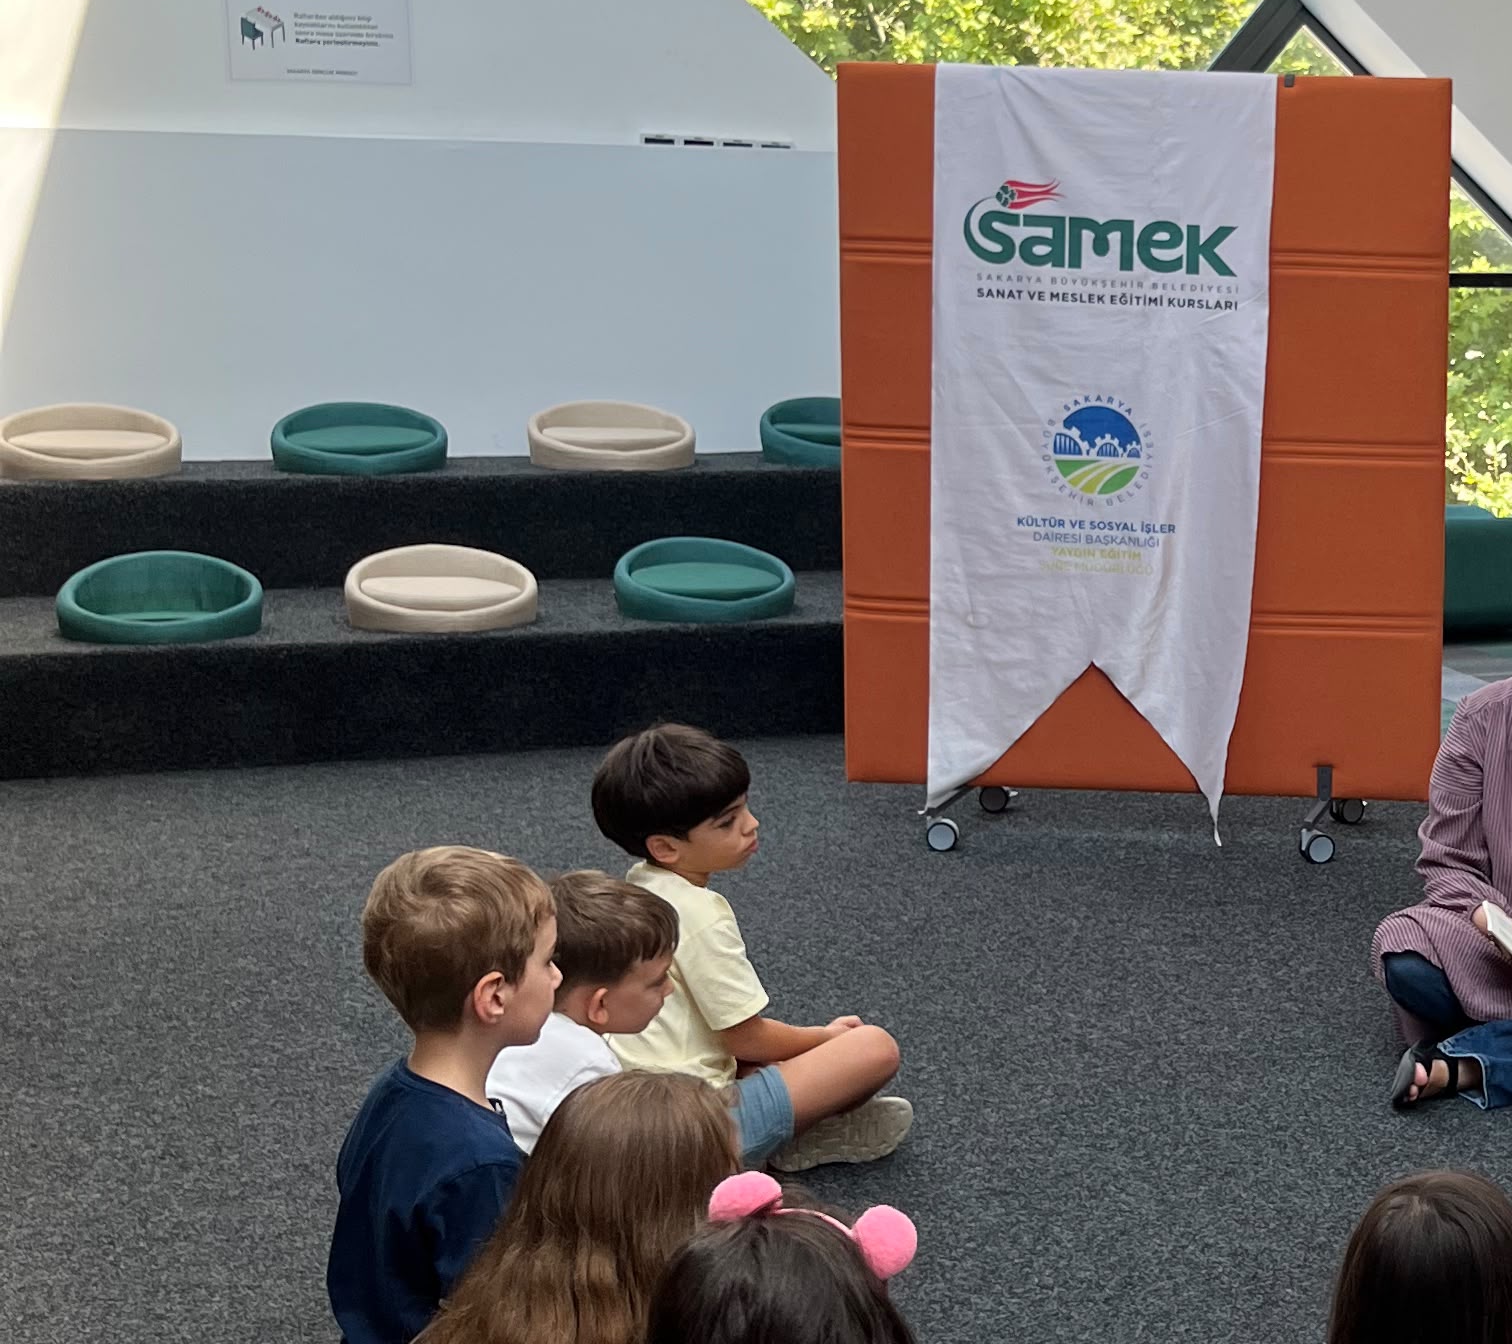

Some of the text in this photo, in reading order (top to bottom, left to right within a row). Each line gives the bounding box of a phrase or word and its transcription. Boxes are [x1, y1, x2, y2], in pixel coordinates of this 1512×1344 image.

[976, 272, 1239, 295] SAKARYA BÜYÜKŞEHİR BELEDİYESİ
[976, 287, 1239, 312] SANAT VE MESLEK EĞİTİMİ KURSLARI
[1063, 395, 1132, 416] SAKARYA
[1017, 516, 1176, 535] KÜLTÜR VE SOSYAL İŞLER
[1033, 531, 1160, 548] DAİRESİ BAŞKANLIĞI
[1052, 547, 1142, 561] YAYGIN EĞİTİM
